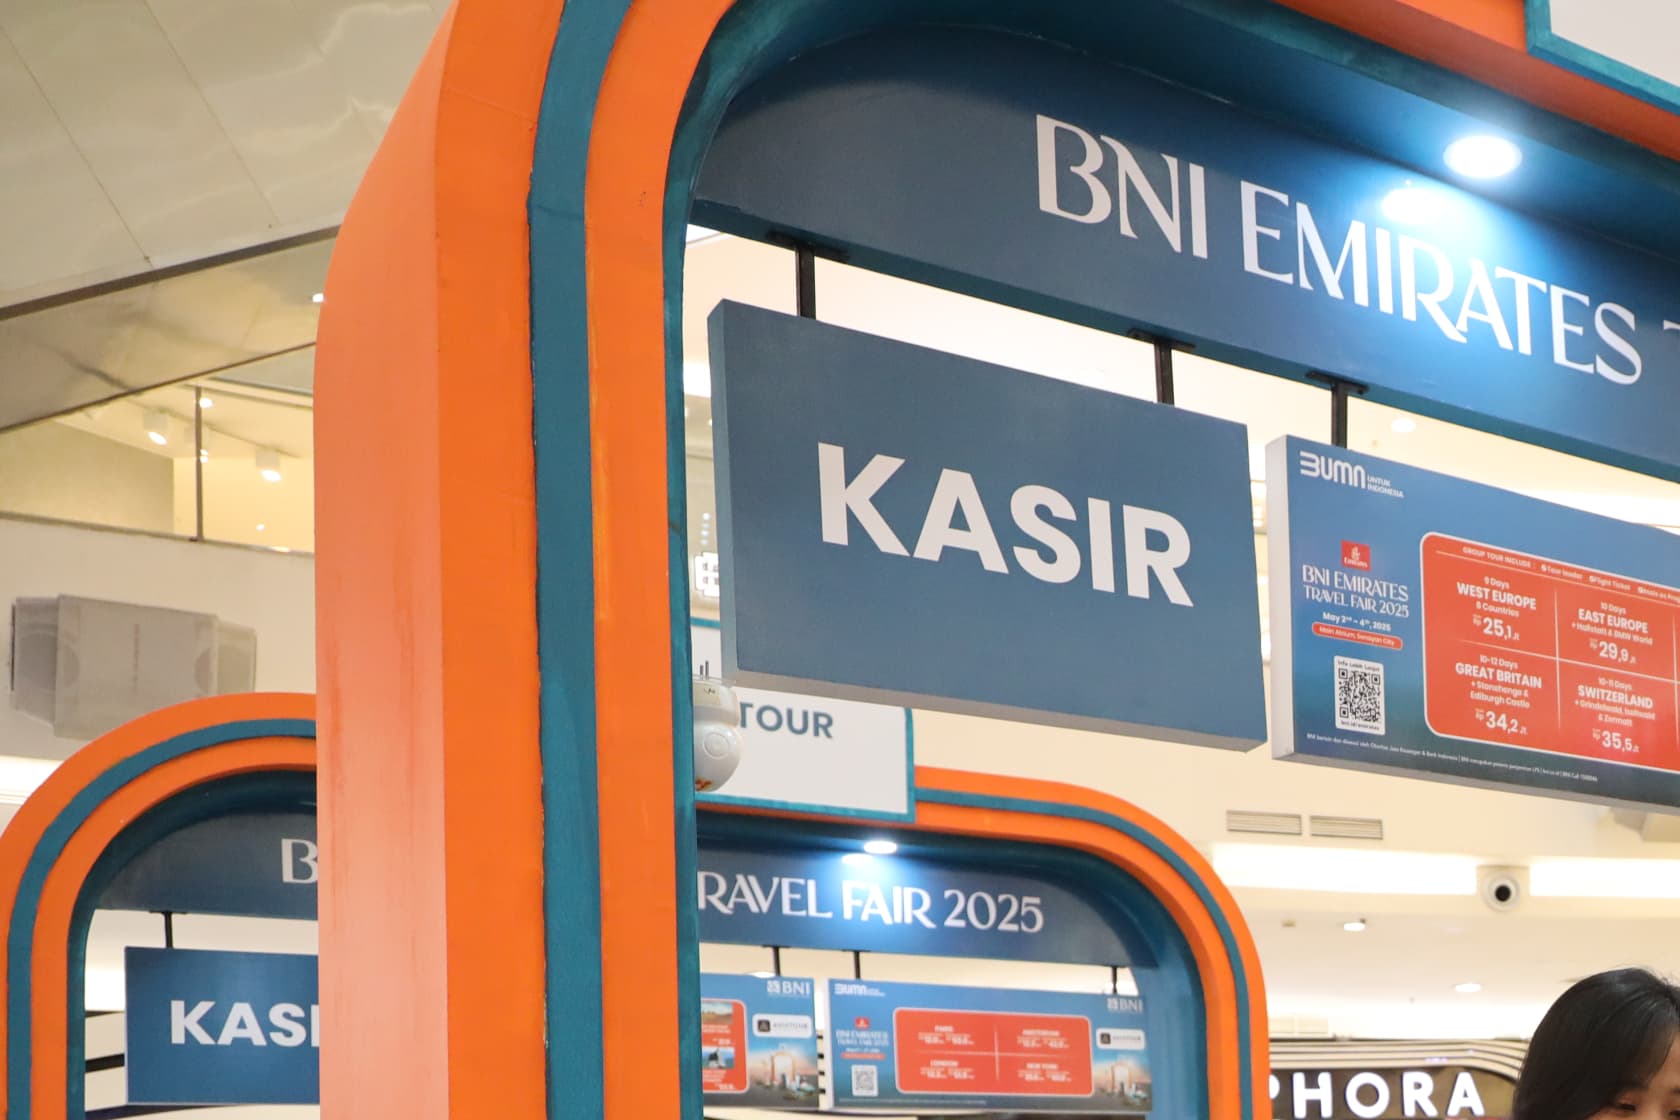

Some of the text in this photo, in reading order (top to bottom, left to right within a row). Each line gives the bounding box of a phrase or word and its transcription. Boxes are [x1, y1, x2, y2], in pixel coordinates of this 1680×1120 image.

[1035, 114, 1209, 260] BNI
[1240, 180, 1642, 386] EMIRATES
[817, 442, 1195, 608] KASIR
[1302, 564, 1409, 602] BNI EMIRATES
[1304, 585, 1409, 618] TRAVEL FAIR 2025
[1457, 582, 1537, 610] WEST EUROPE
[1322, 611, 1342, 625] May
[1373, 619, 1391, 632] 2025
[1482, 602, 1519, 618] Countries
[1578, 608, 1648, 634] EAST EUROPE
[1483, 617, 1512, 640] 25,1
[1499, 657, 1518, 670] Days
[1599, 641, 1628, 662] 29,9
[1456, 662, 1542, 689] GREAT BRITAIN
[1477, 680, 1522, 698] Stonehenge
[1577, 685, 1653, 709] SWITZERLAND
[1505, 696, 1530, 709] Castle
[1486, 711, 1518, 735] 34,2
[697, 871, 1044, 934] RAVEL FAIR 2025
[782, 981, 811, 996] BNI
[1119, 999, 1143, 1012] BNI
[171, 1000, 319, 1047] KASI
